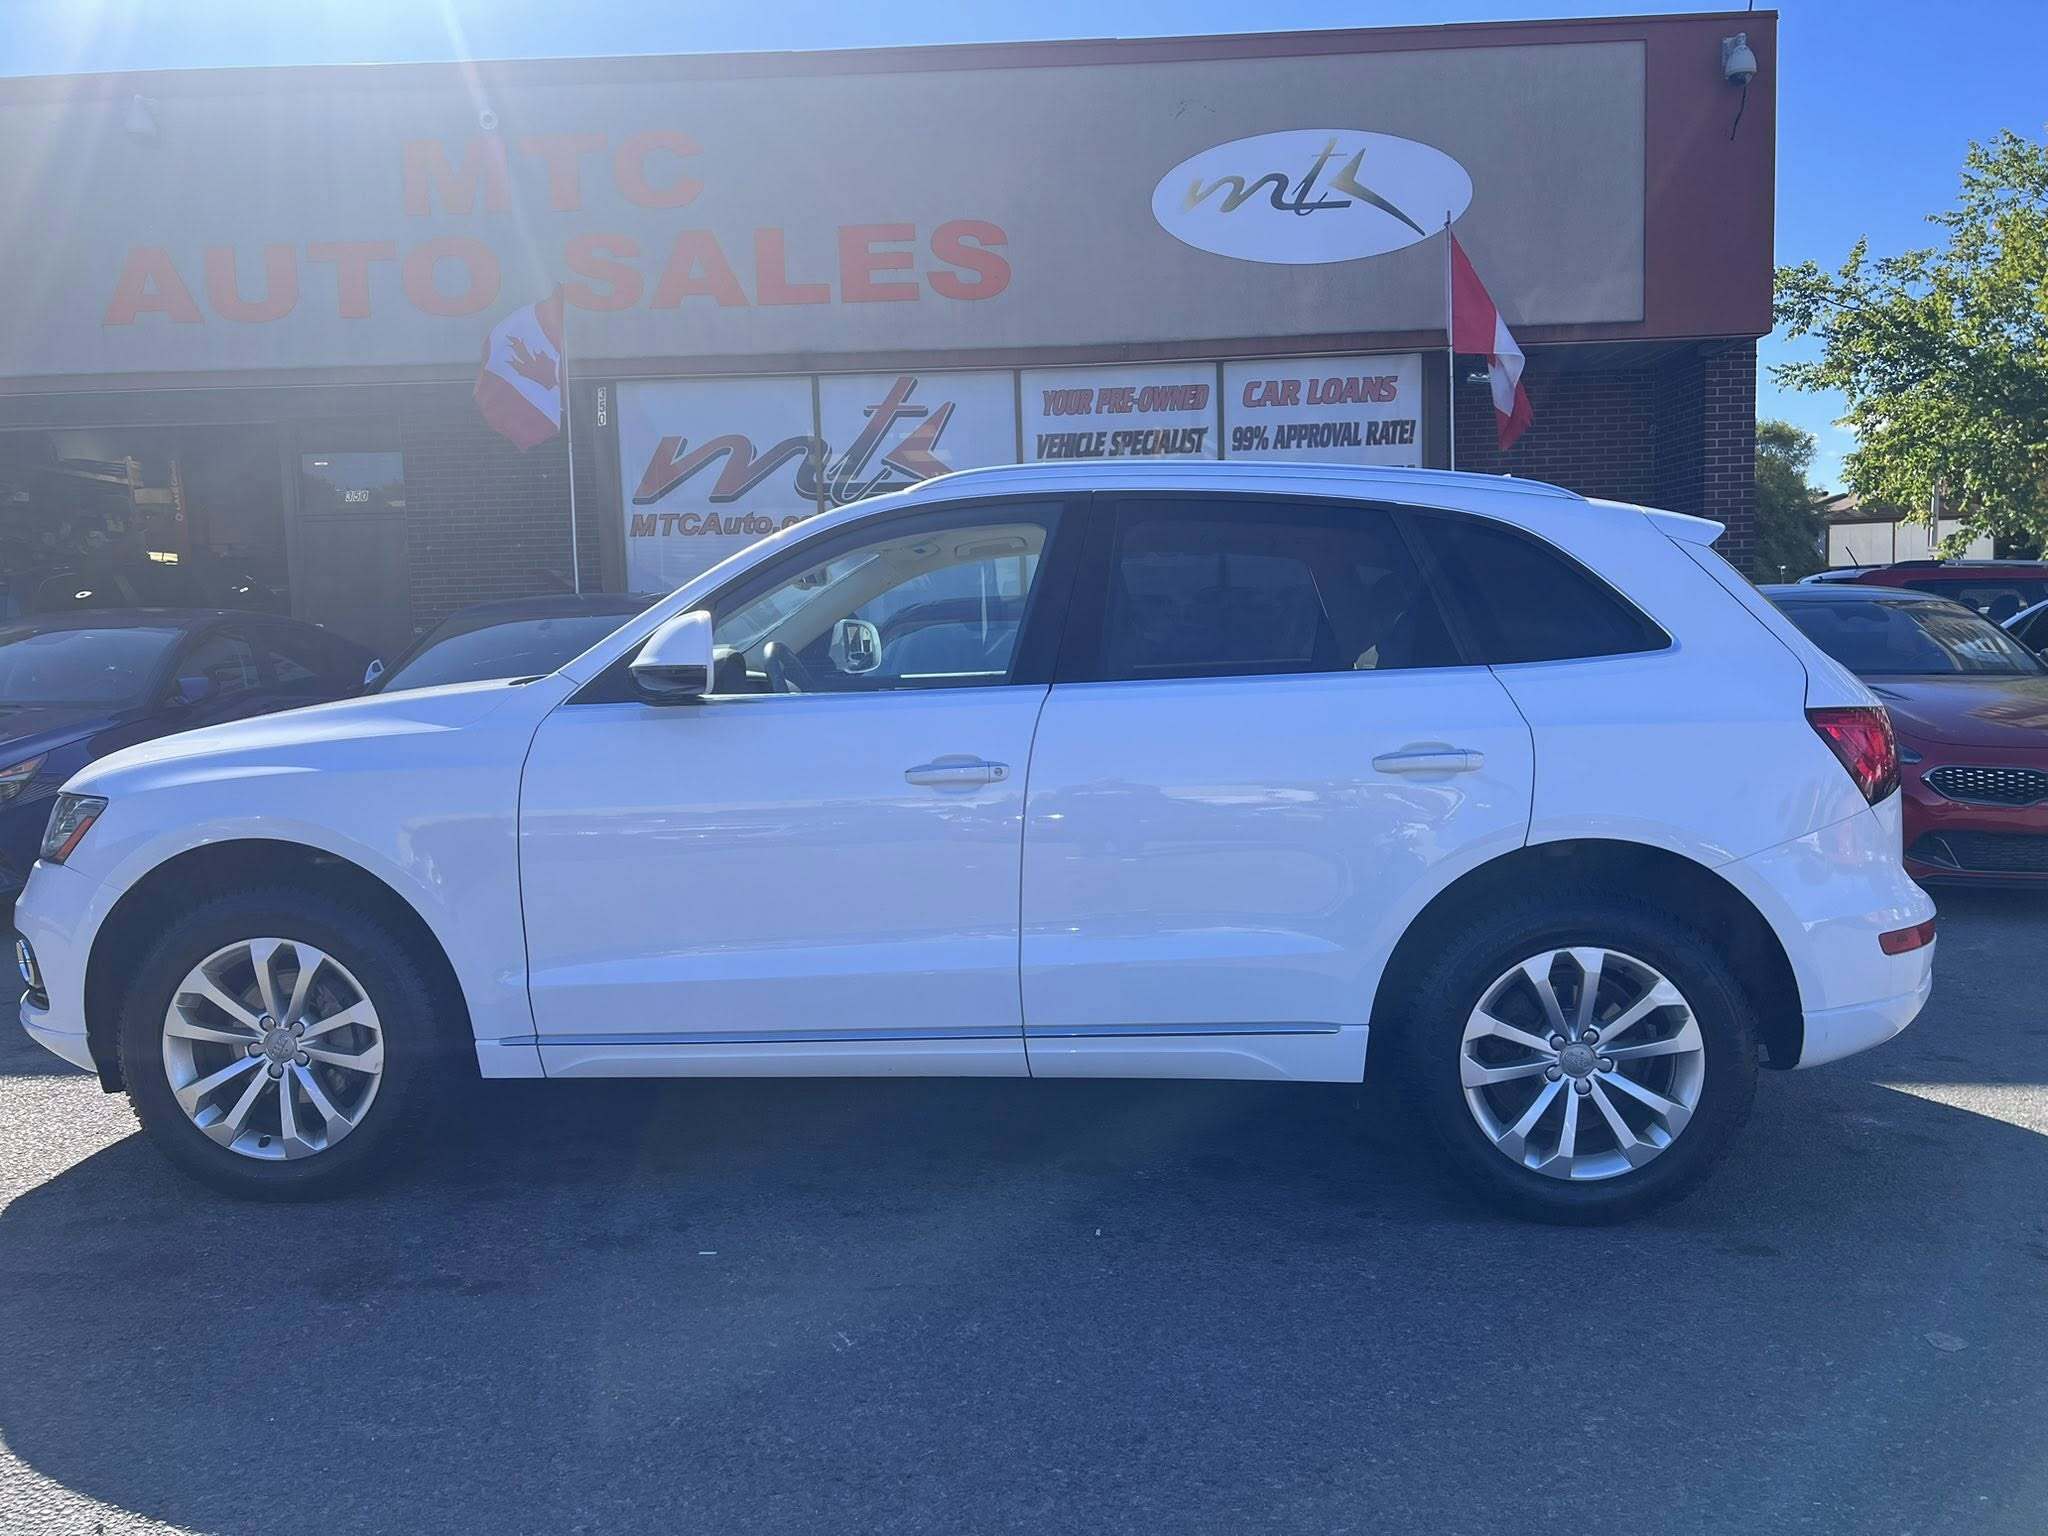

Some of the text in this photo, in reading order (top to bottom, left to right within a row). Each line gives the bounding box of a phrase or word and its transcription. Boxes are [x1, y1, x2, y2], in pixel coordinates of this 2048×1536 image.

[404, 129, 706, 216] MTC
[102, 219, 1012, 327] AUTO SALES
[1042, 384, 1210, 416] YOUR PRE-OWNED
[1242, 375, 1398, 408] CAR LOANS
[1037, 426, 1208, 459] VEHICLE SPECIALIST
[1231, 419, 1416, 451] 99% APPROVAL RATE!
[629, 512, 822, 538] MTCAuto.c
